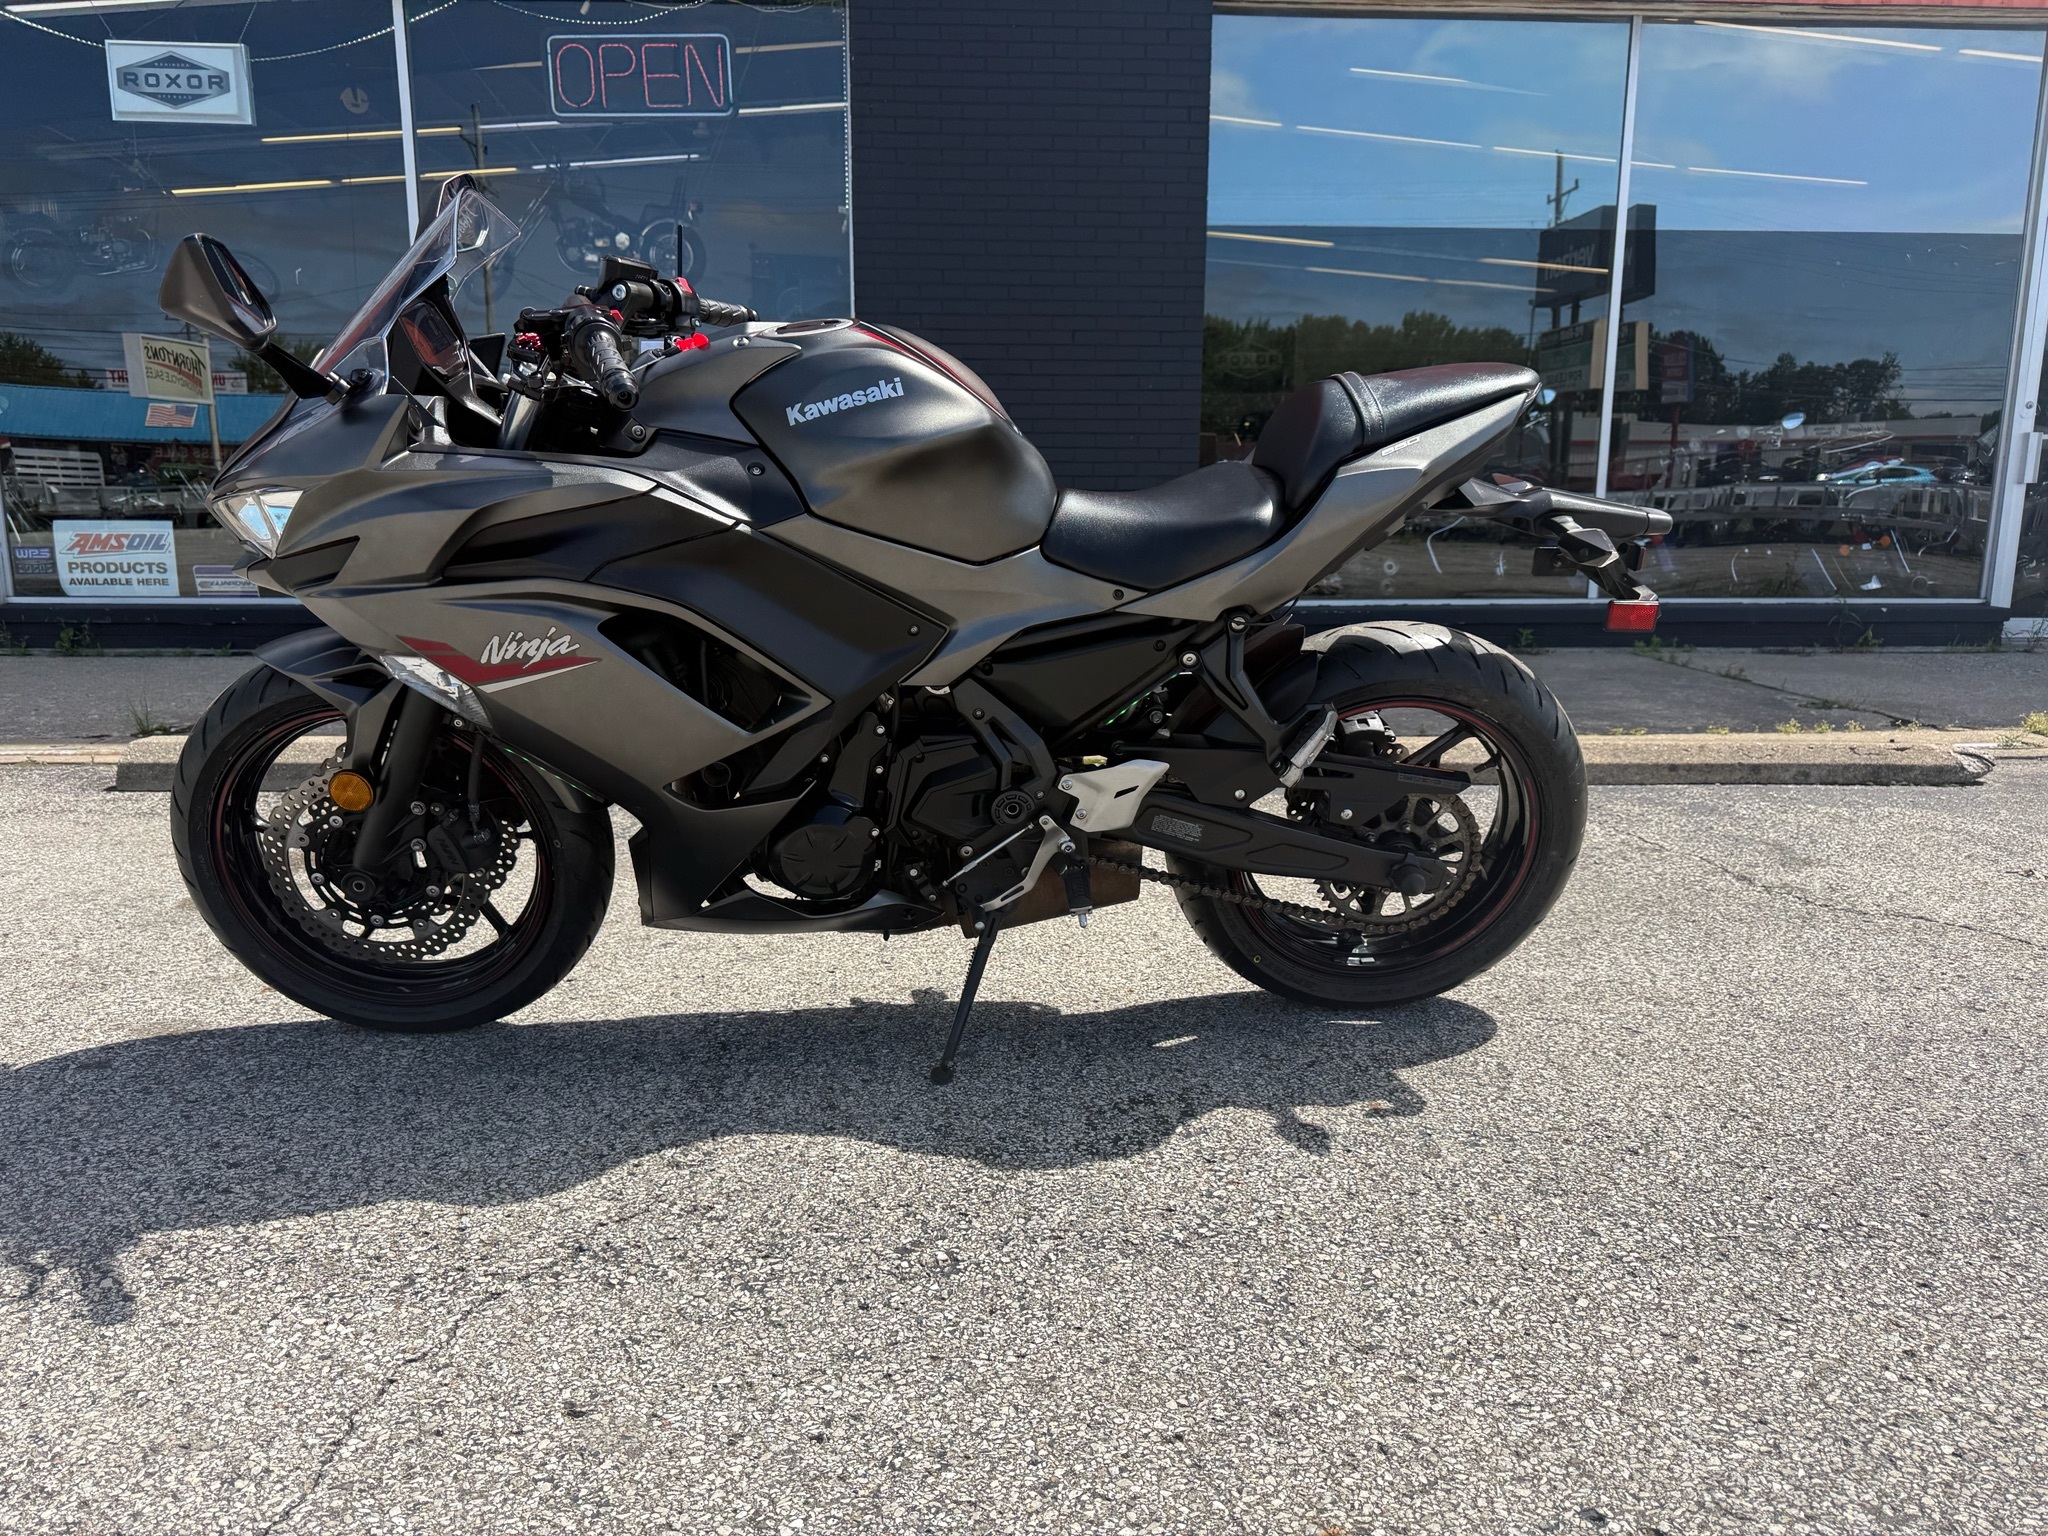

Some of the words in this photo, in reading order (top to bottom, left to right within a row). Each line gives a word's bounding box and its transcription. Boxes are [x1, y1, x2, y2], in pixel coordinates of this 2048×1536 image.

[123, 71, 224, 90] ROXOR
[555, 43, 725, 109] OPEN
[785, 377, 904, 426] Kawasaki
[15, 548, 51, 559] WPS
[66, 533, 168, 556] AMSOIL
[67, 561, 168, 575] PRODUCTS
[69, 577, 133, 586] AVAILABLE
[137, 577, 170, 587] HERE
[480, 626, 580, 669] Ninja
